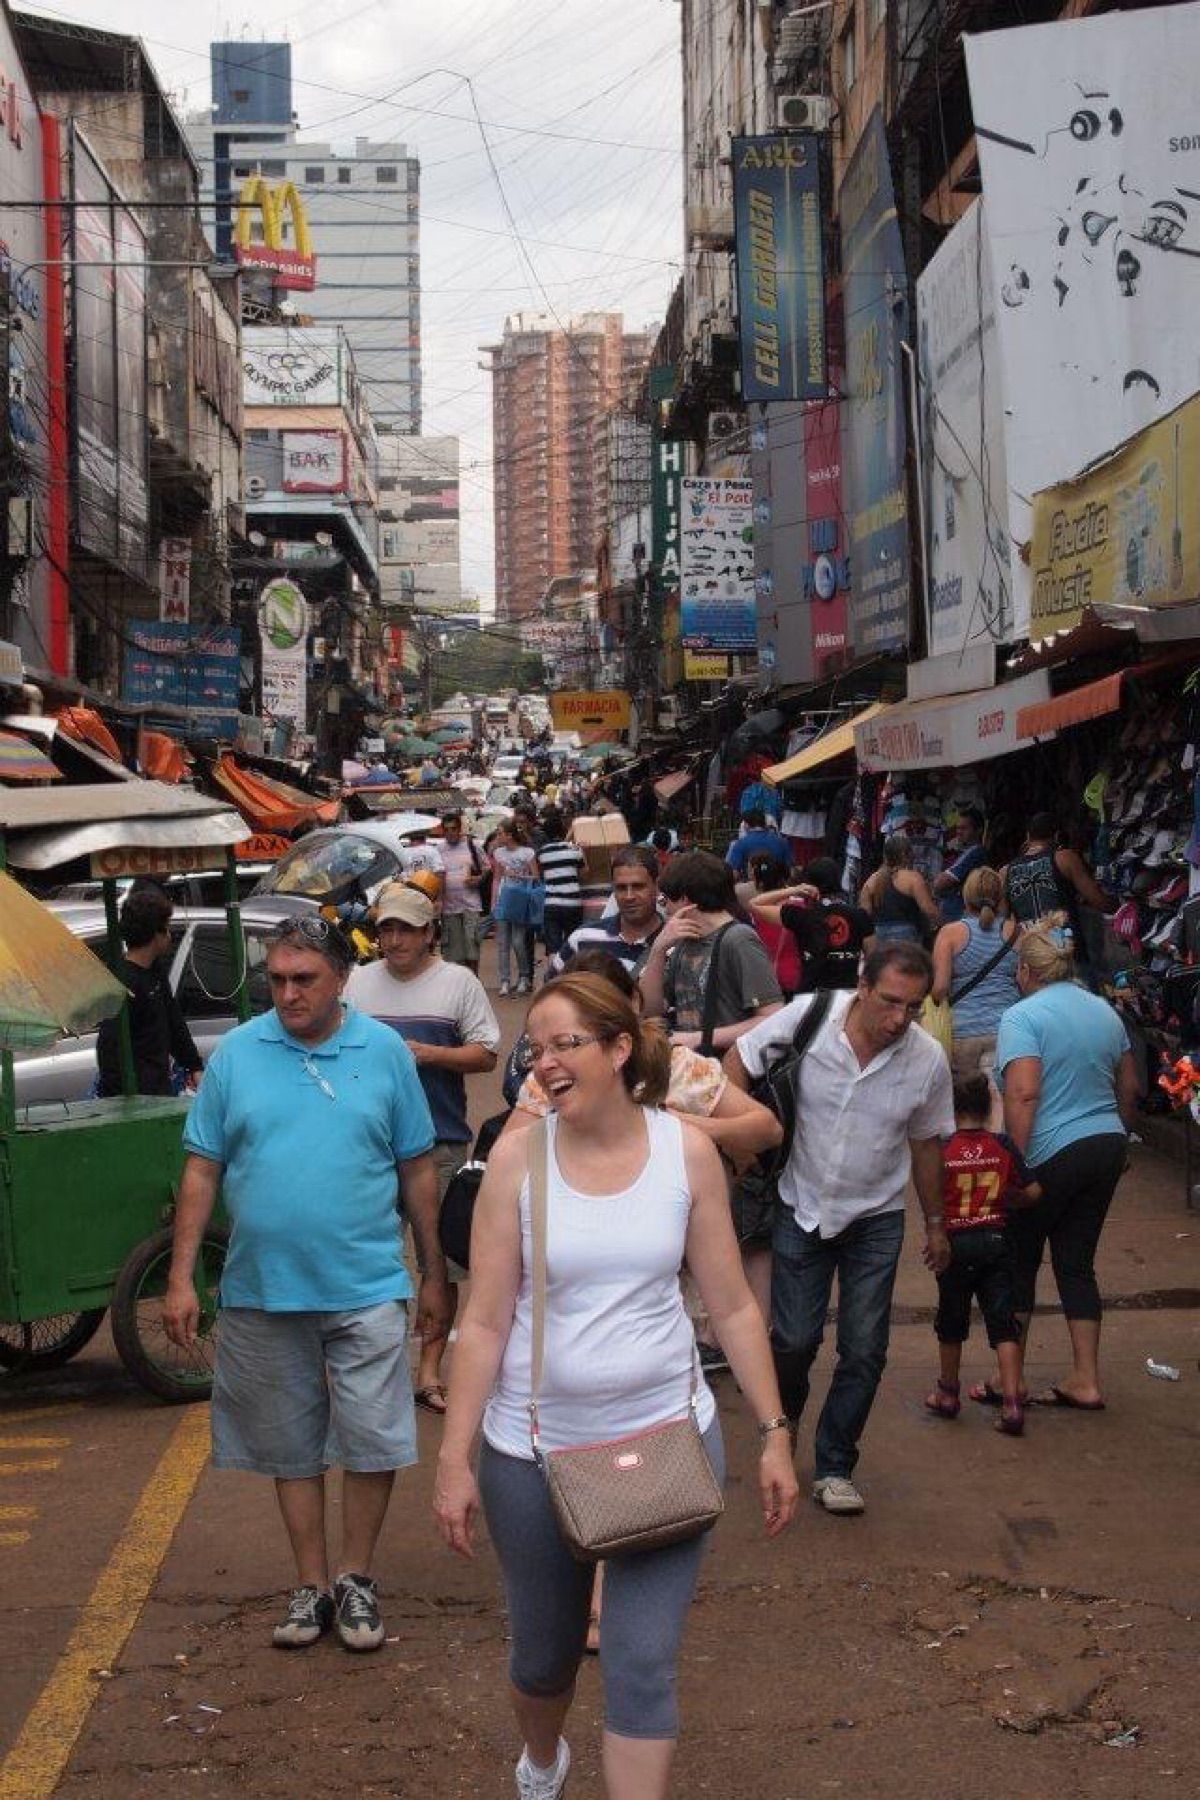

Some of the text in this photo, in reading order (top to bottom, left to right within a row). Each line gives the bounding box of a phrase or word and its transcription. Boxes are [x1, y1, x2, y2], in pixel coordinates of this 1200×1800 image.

[243, 362, 334, 395] OLYMPIC GAMES
[815, 632, 845, 648] Nikon
[956, 1171, 1000, 1217] 17
